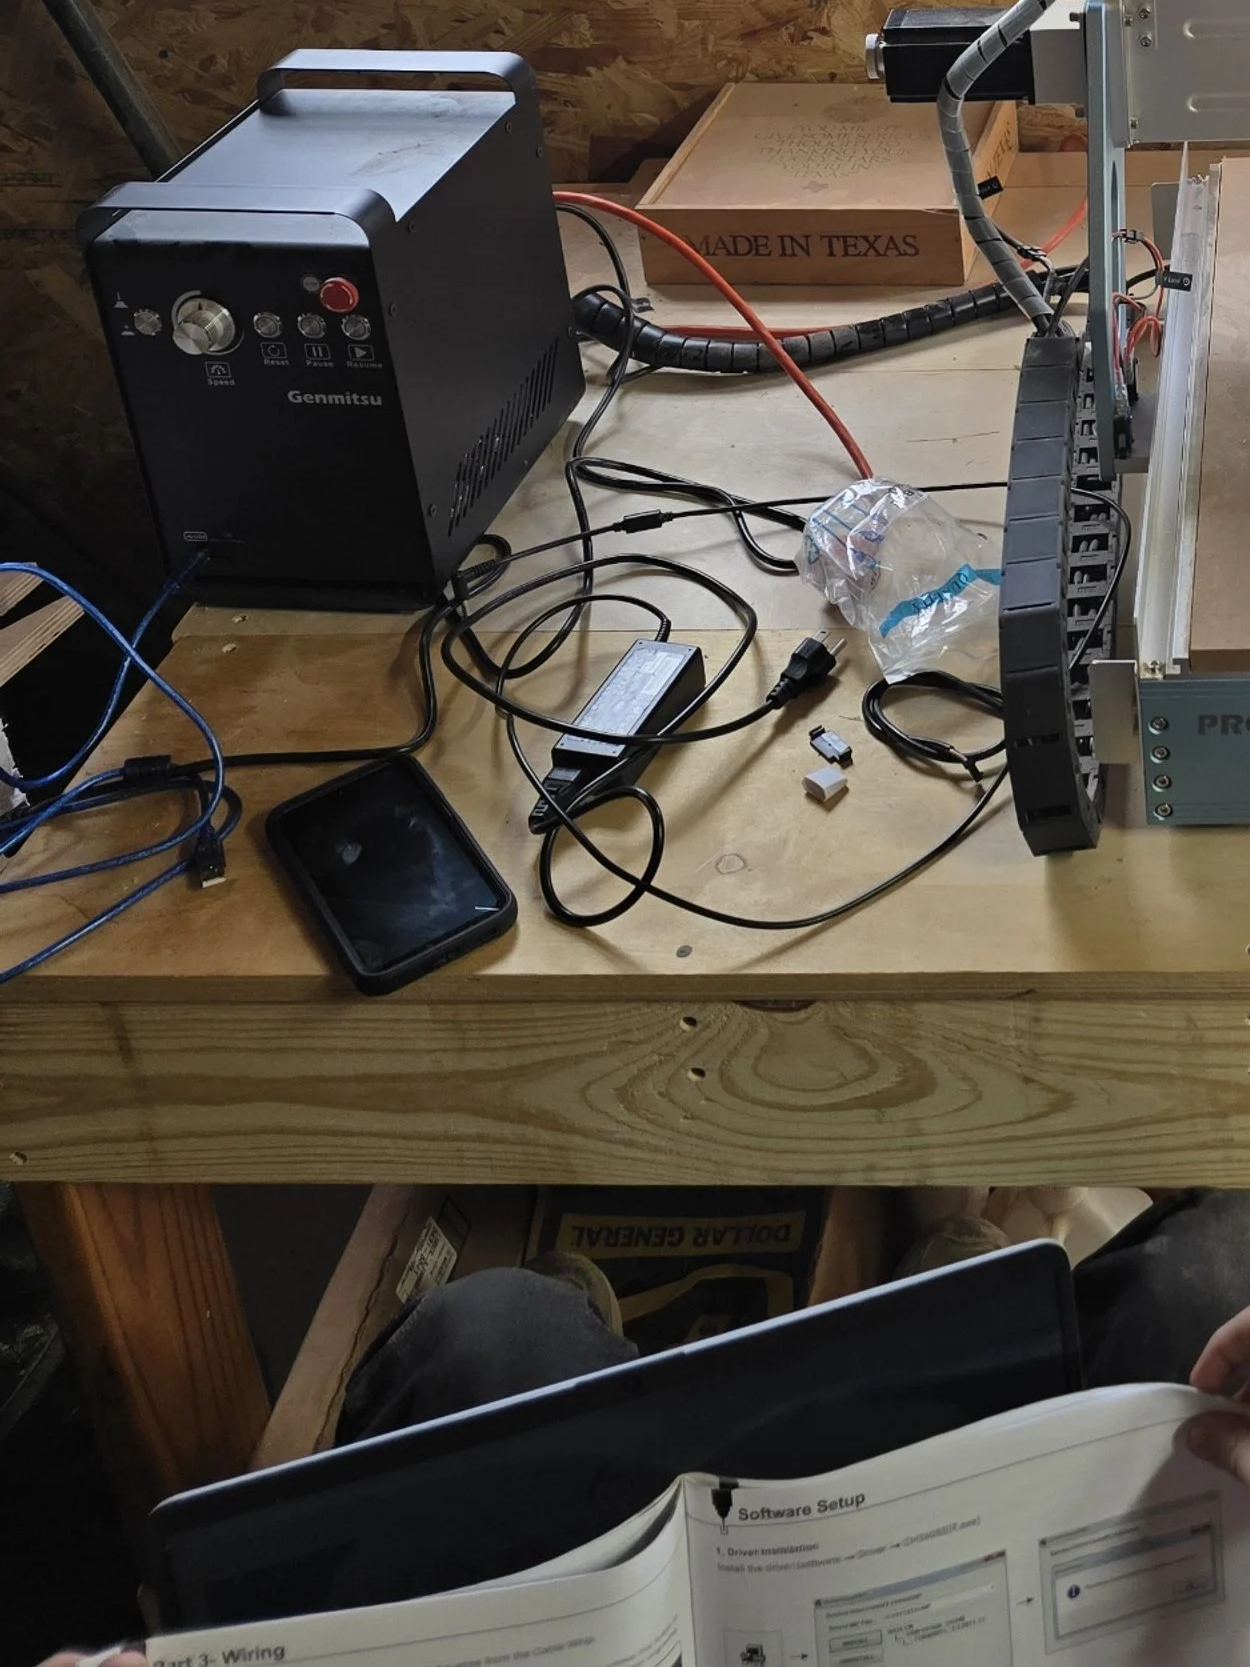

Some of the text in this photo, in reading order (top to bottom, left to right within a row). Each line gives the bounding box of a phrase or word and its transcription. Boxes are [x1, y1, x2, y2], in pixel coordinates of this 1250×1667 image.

[684, 234, 920, 258] MADE IN TEXAS
[287, 390, 382, 406] Genmitsu
[572, 1222, 792, 1250] DOLLAR GENERAL
[738, 1492, 866, 1522] Software Setup
[221, 1645, 287, 1665] Wiring
